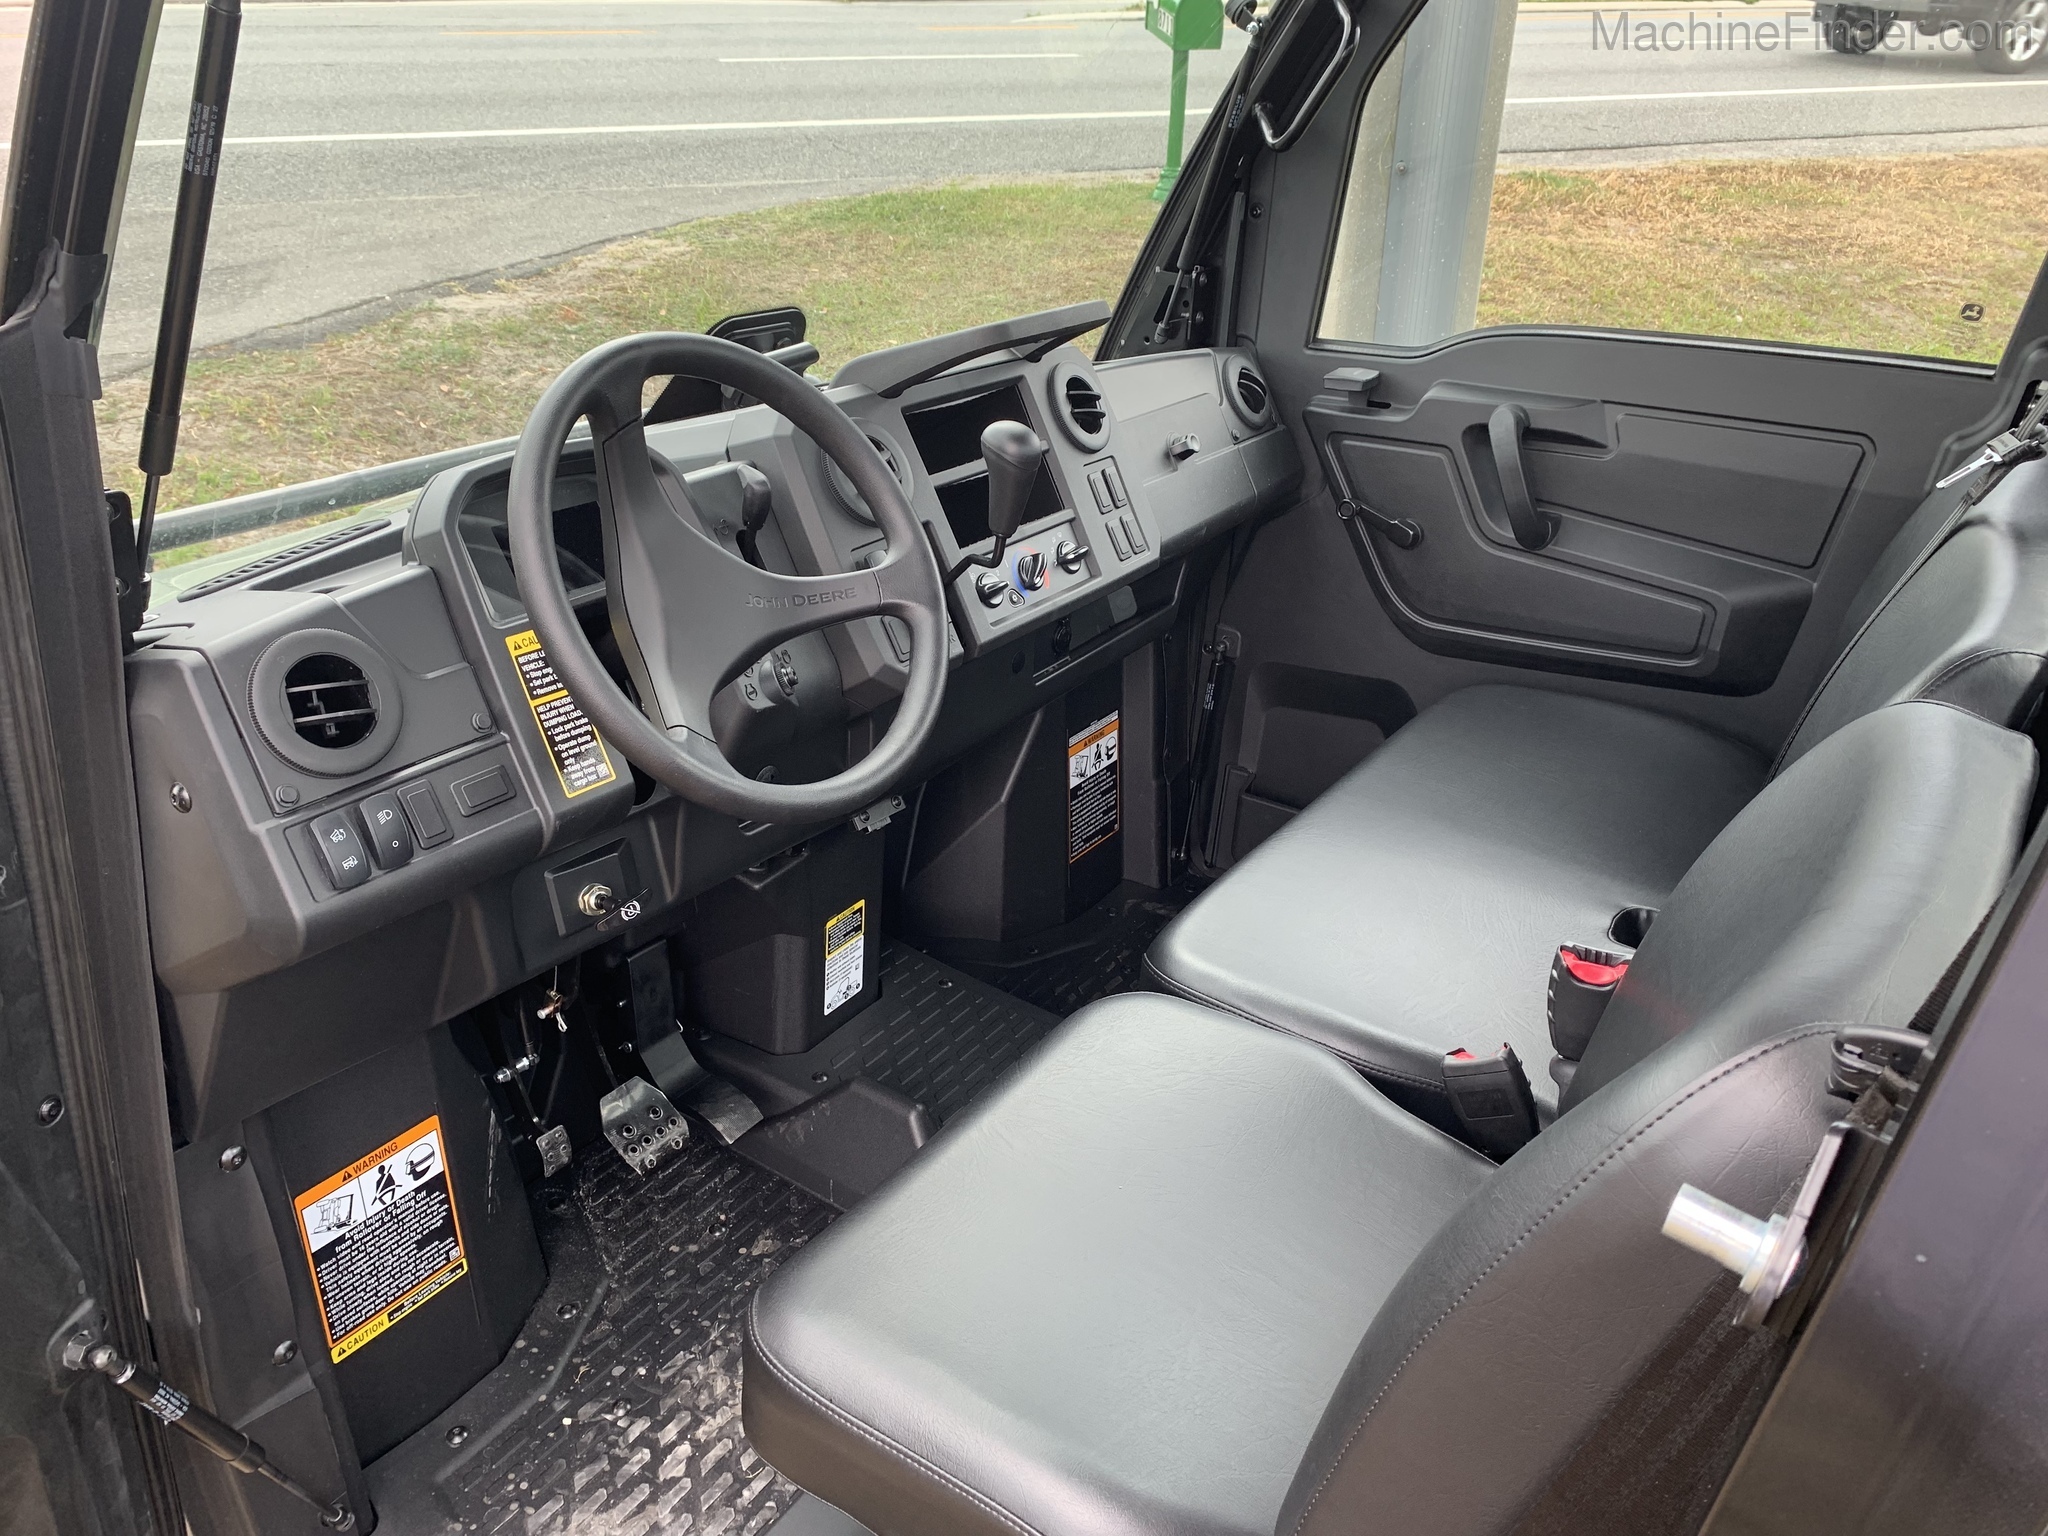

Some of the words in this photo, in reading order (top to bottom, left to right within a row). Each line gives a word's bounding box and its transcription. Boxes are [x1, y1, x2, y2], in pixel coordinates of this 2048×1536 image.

[745, 592, 789, 609] JOHN
[792, 586, 858, 607] DEERE
[353, 1142, 398, 1174] WARNING
[335, 1240, 352, 1253] from
[353, 1220, 382, 1241] Rollover
[383, 1214, 391, 1222] or
[392, 1199, 415, 1216] Falling
[416, 1190, 426, 1201] Off
[345, 1223, 365, 1240] Avoid
[366, 1210, 385, 1226] Injury
[387, 1204, 396, 1212] or
[396, 1192, 415, 1207] Death
[347, 1320, 384, 1350] CAUTION
